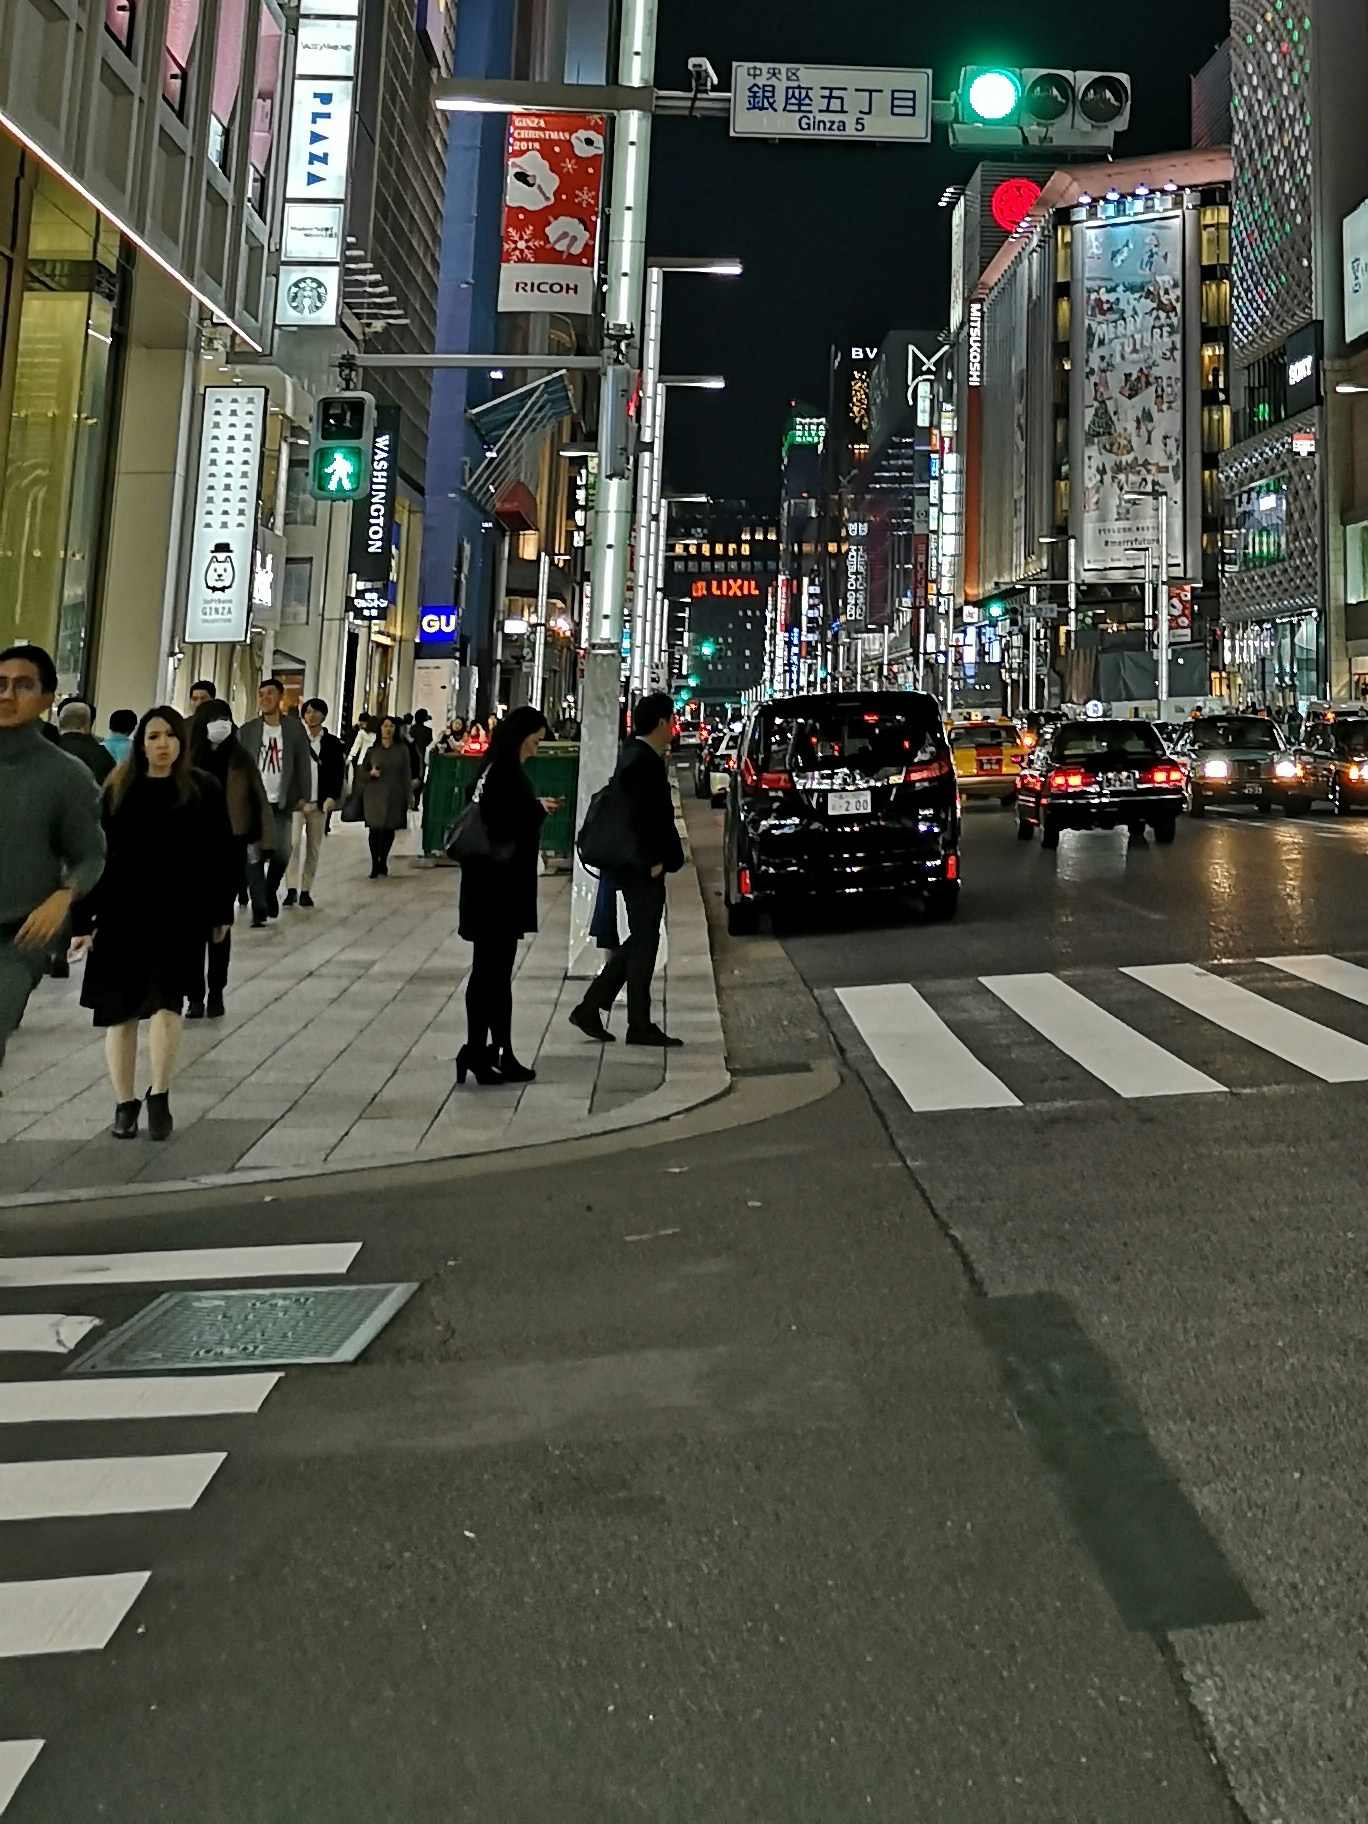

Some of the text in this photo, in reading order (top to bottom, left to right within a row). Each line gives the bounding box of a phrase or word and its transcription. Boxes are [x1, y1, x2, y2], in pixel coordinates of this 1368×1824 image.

[746, 65, 801, 83] 中央区
[745, 82, 917, 118] 銀座五丁目
[514, 117, 546, 128] GINZA
[798, 114, 866, 133] Ginza 5
[306, 91, 333, 187] PLAZA
[513, 141, 541, 151] 2018
[514, 281, 579, 295] RICOH
[1093, 315, 1144, 350] MERRY
[968, 303, 982, 387] MITSUKOSHI
[1111, 326, 1172, 364] FUTURE
[1288, 355, 1314, 386] SONY
[367, 433, 390, 554] WASHINGTON
[711, 579, 760, 597] LIXIL
[201, 606, 233, 616] GINZA
[421, 614, 457, 634] GU
